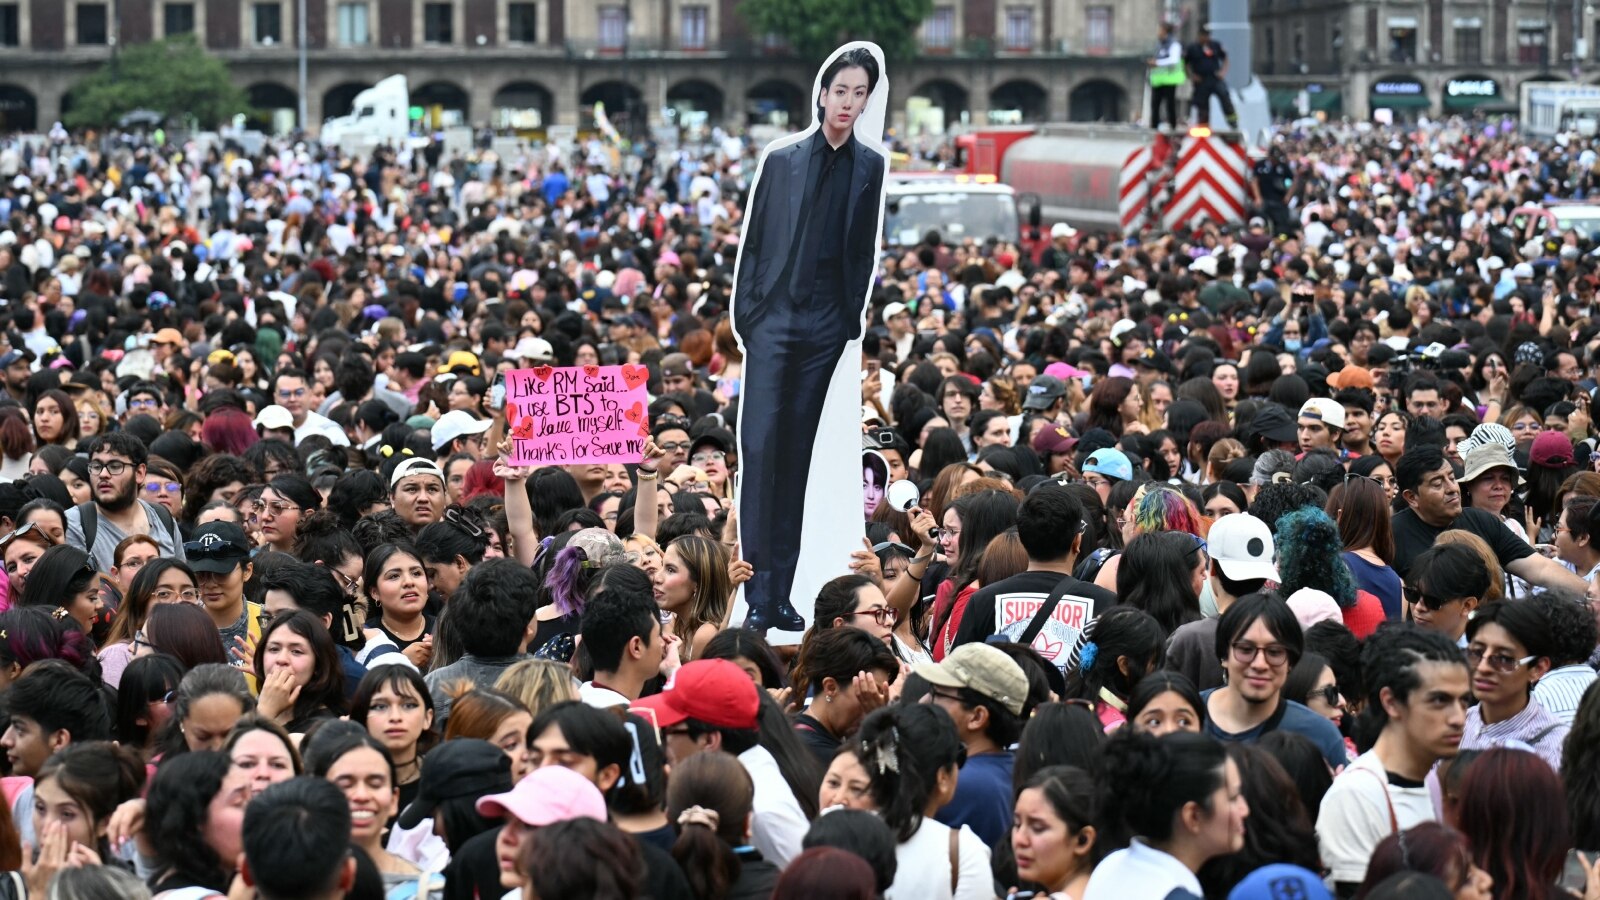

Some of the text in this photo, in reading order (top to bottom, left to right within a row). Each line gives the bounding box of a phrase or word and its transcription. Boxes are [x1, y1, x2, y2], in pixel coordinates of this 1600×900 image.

[513, 374, 549, 398] Like
[553, 370, 577, 394] RM
[527, 400, 549, 417] use
[556, 393, 595, 416] BTS
[600, 394, 618, 412] to
[513, 436, 644, 461] Thanks for Save me
[1005, 601, 1083, 630] SUPIOR
